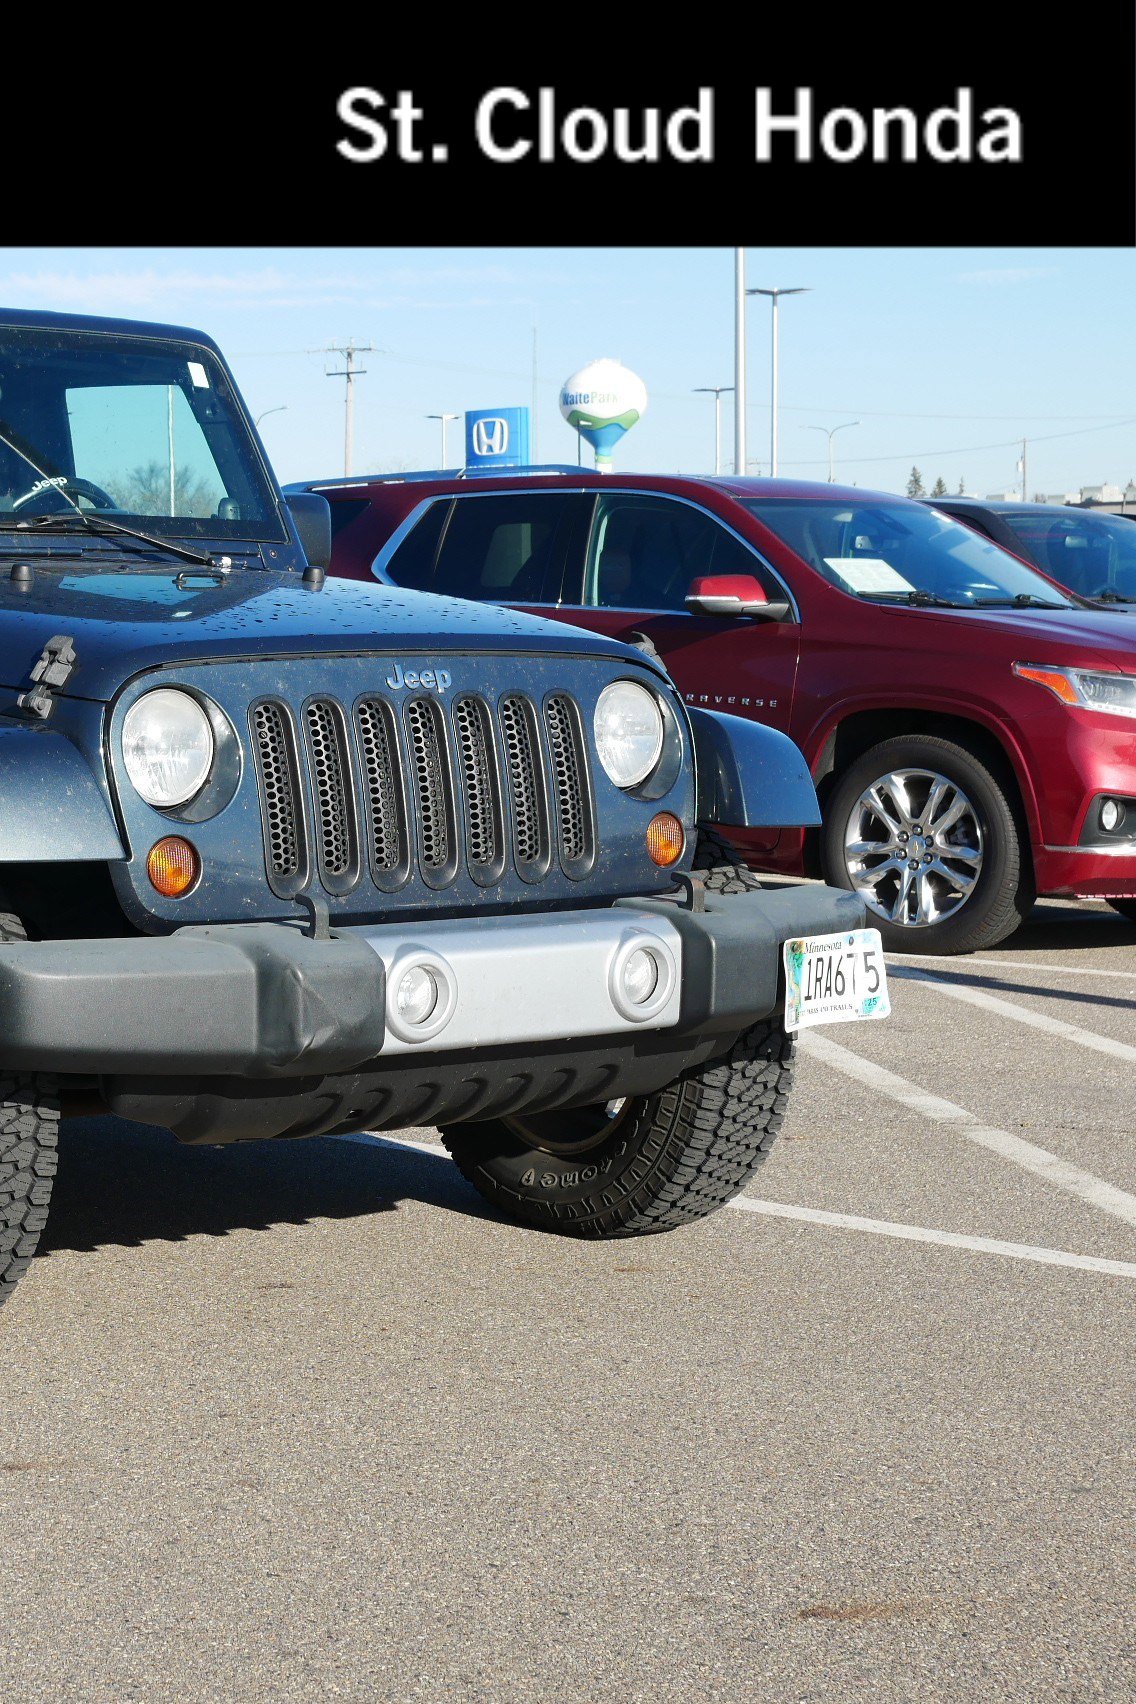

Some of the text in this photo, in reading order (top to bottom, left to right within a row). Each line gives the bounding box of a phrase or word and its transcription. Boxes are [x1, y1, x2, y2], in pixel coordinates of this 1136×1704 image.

[32, 476, 68, 491] Jeep
[385, 664, 452, 694] Jeep
[805, 941, 843, 954] Minnesota
